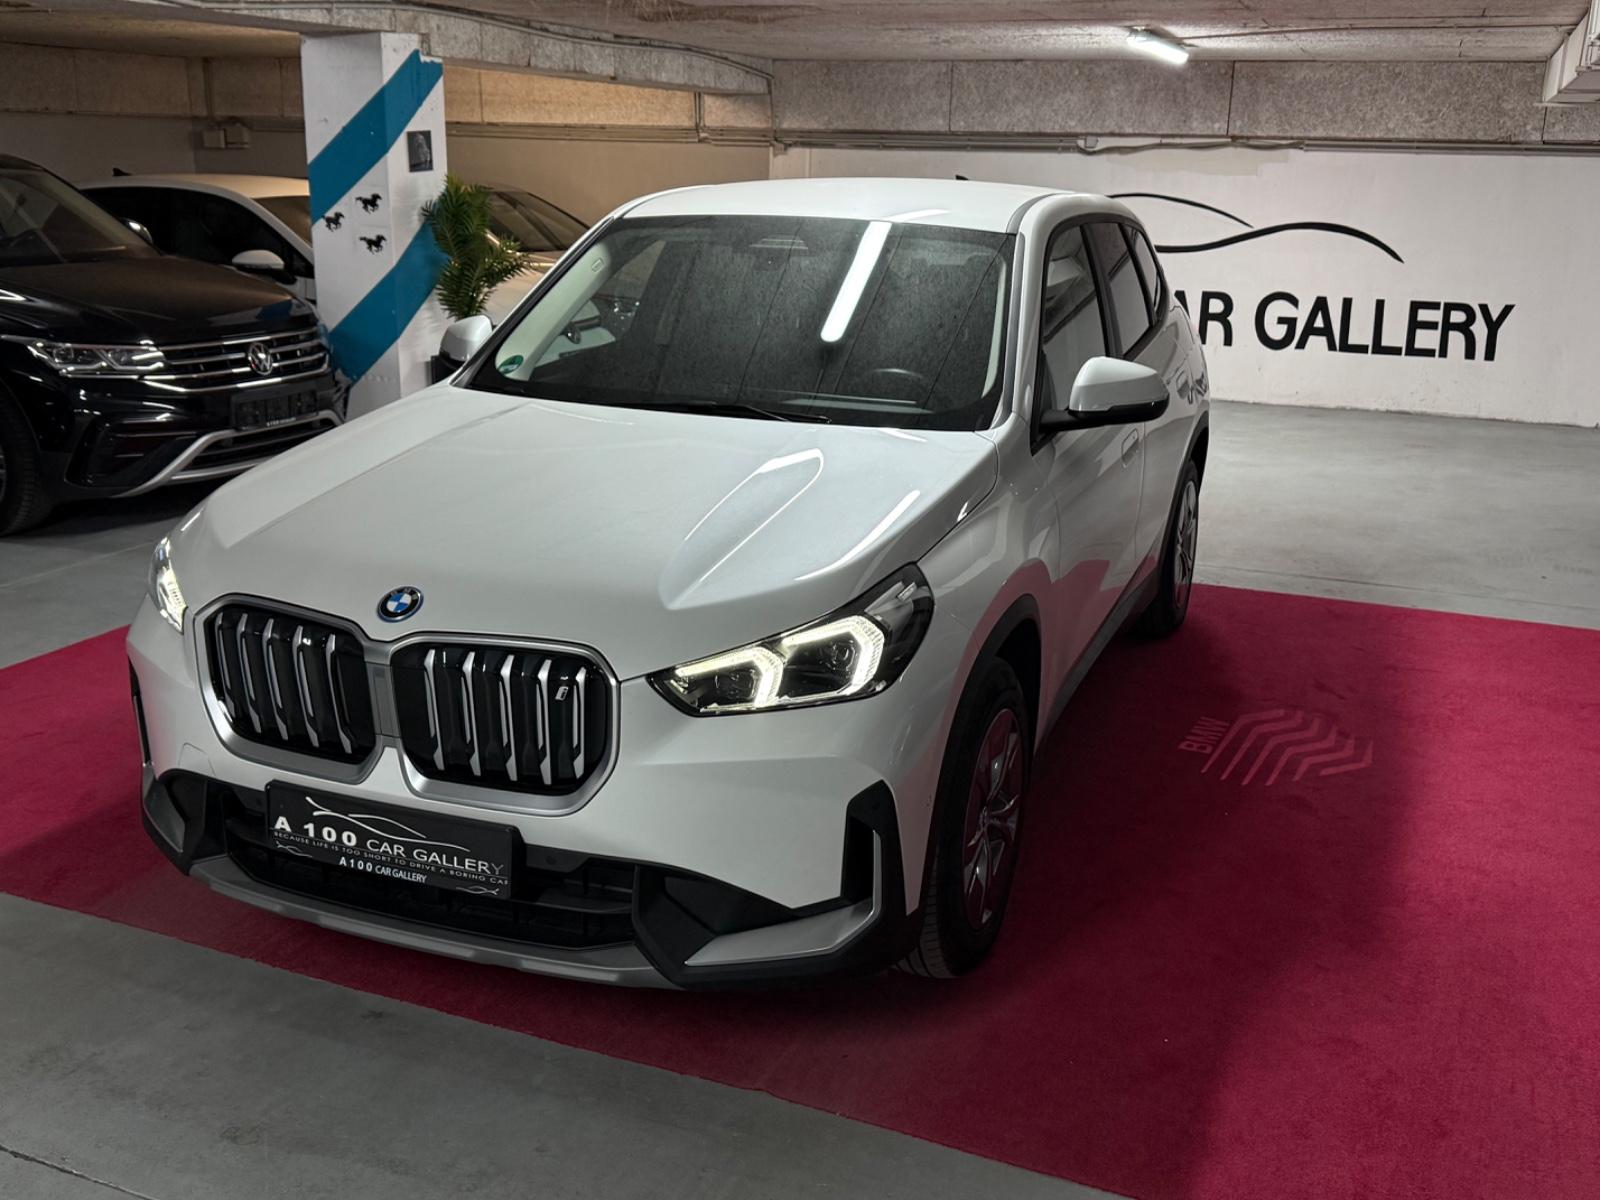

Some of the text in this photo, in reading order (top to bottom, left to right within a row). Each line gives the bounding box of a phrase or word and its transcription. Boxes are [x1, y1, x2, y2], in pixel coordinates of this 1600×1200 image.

[1254, 291, 1516, 361] GALLERY
[1178, 716, 1230, 754] BMW
[274, 815, 504, 875] A 100 CAR GALLERY
[274, 831, 309, 844] BECAUSE
[313, 840, 328, 849] LIFE
[331, 844, 340, 852] IS
[342, 847, 361, 856] TOO
[364, 852, 391, 861] SHORT
[395, 858, 406, 866] TO
[409, 861, 436, 872] DRIVE
[449, 869, 486, 882] BORING
